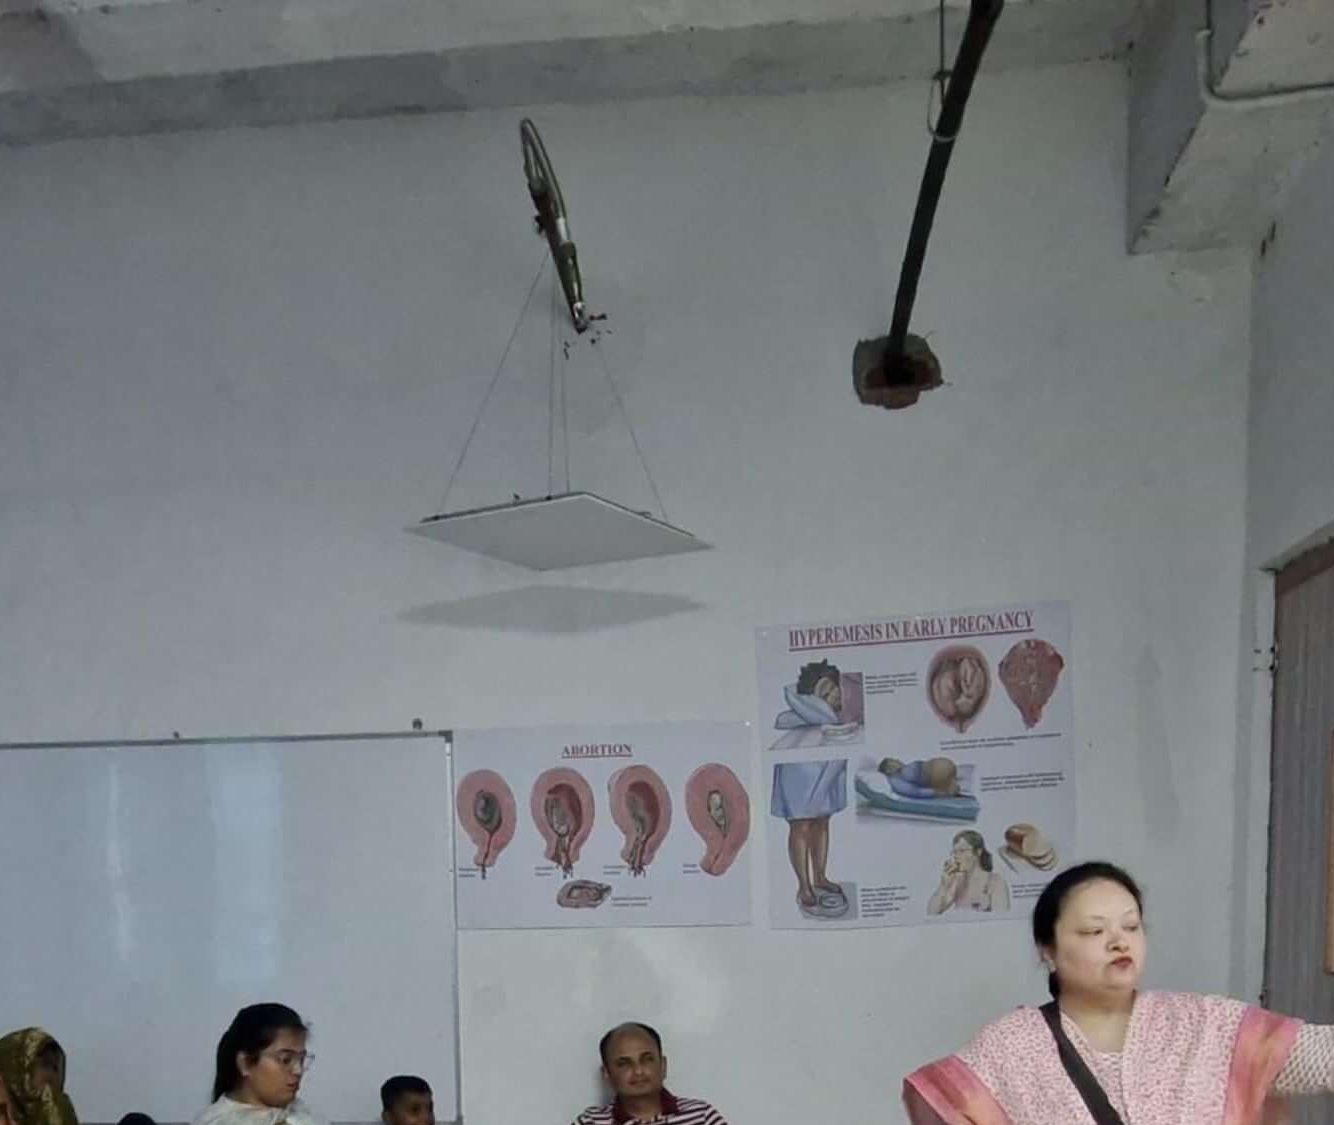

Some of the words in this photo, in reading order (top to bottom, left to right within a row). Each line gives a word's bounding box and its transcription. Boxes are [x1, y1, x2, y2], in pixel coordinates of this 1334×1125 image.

[789, 622, 883, 647] HYPEREMESIS
[885, 620, 901, 638] IN
[903, 616, 947, 637] EARLY
[950, 610, 1034, 635] PREGNANCY
[562, 743, 632, 755] ABORTION
